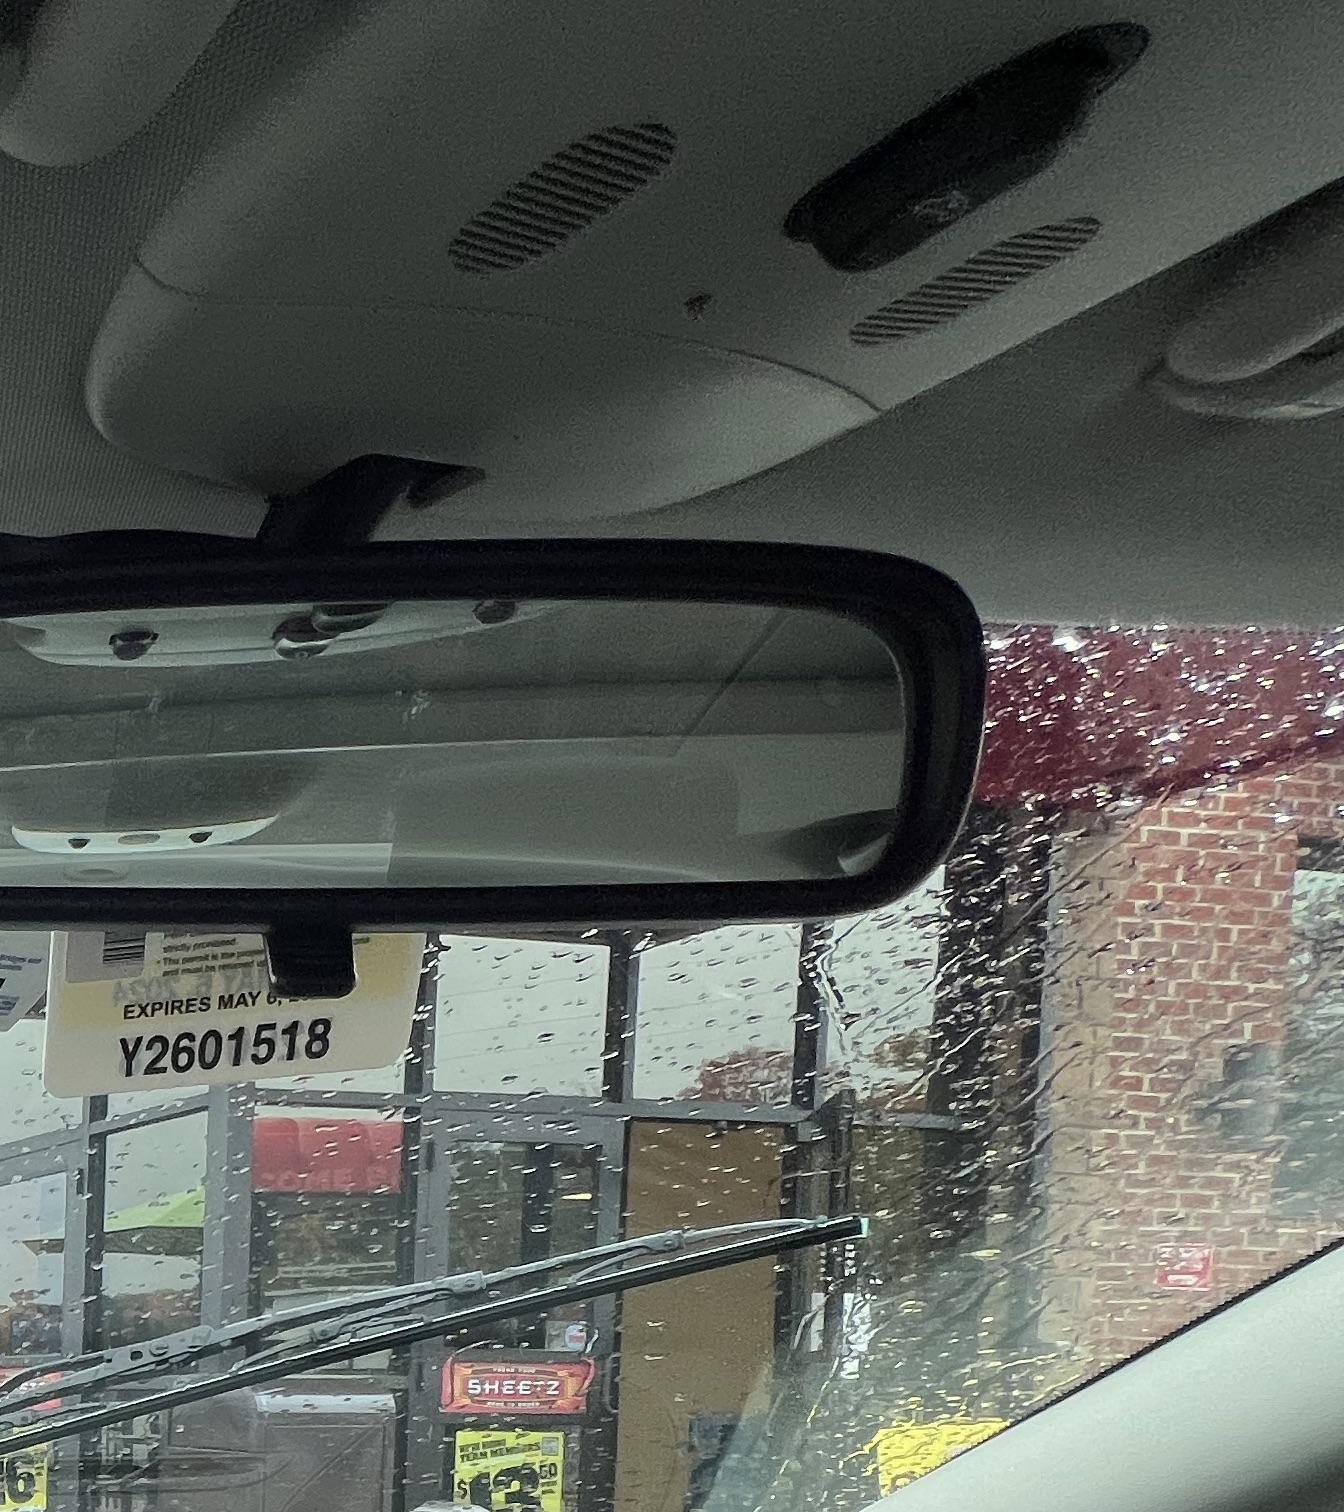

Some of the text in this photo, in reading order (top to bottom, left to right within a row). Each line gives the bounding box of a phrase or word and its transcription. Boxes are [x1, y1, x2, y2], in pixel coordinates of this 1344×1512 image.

[123, 995, 211, 1020] EXPIRES
[217, 990, 261, 1011] MAY
[119, 1017, 332, 1077] Y2601518
[467, 1379, 560, 1395] SHEETZ
